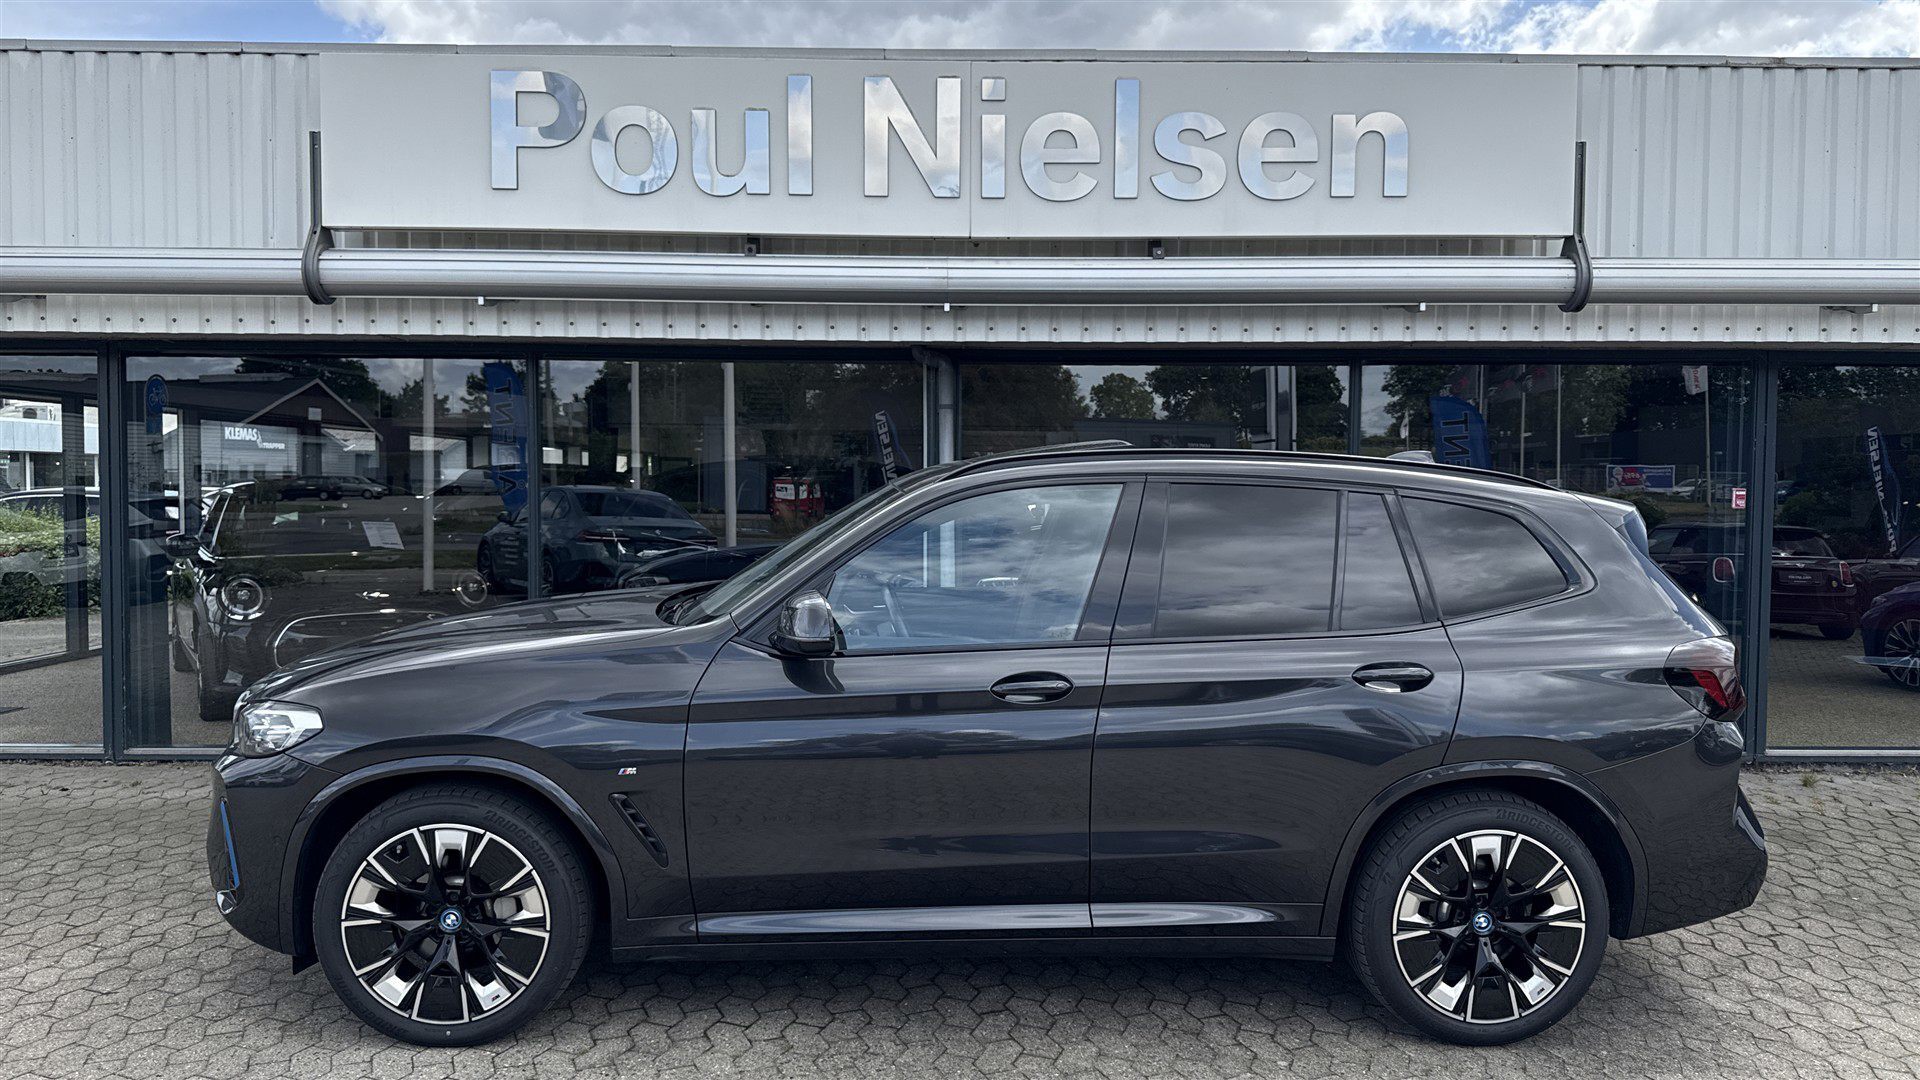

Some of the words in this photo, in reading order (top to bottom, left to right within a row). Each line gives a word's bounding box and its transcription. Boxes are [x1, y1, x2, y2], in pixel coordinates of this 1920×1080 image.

[490, 70, 813, 197] Poul
[864, 76, 1409, 202] Nielsen
[224, 426, 258, 441] KLEMAS
